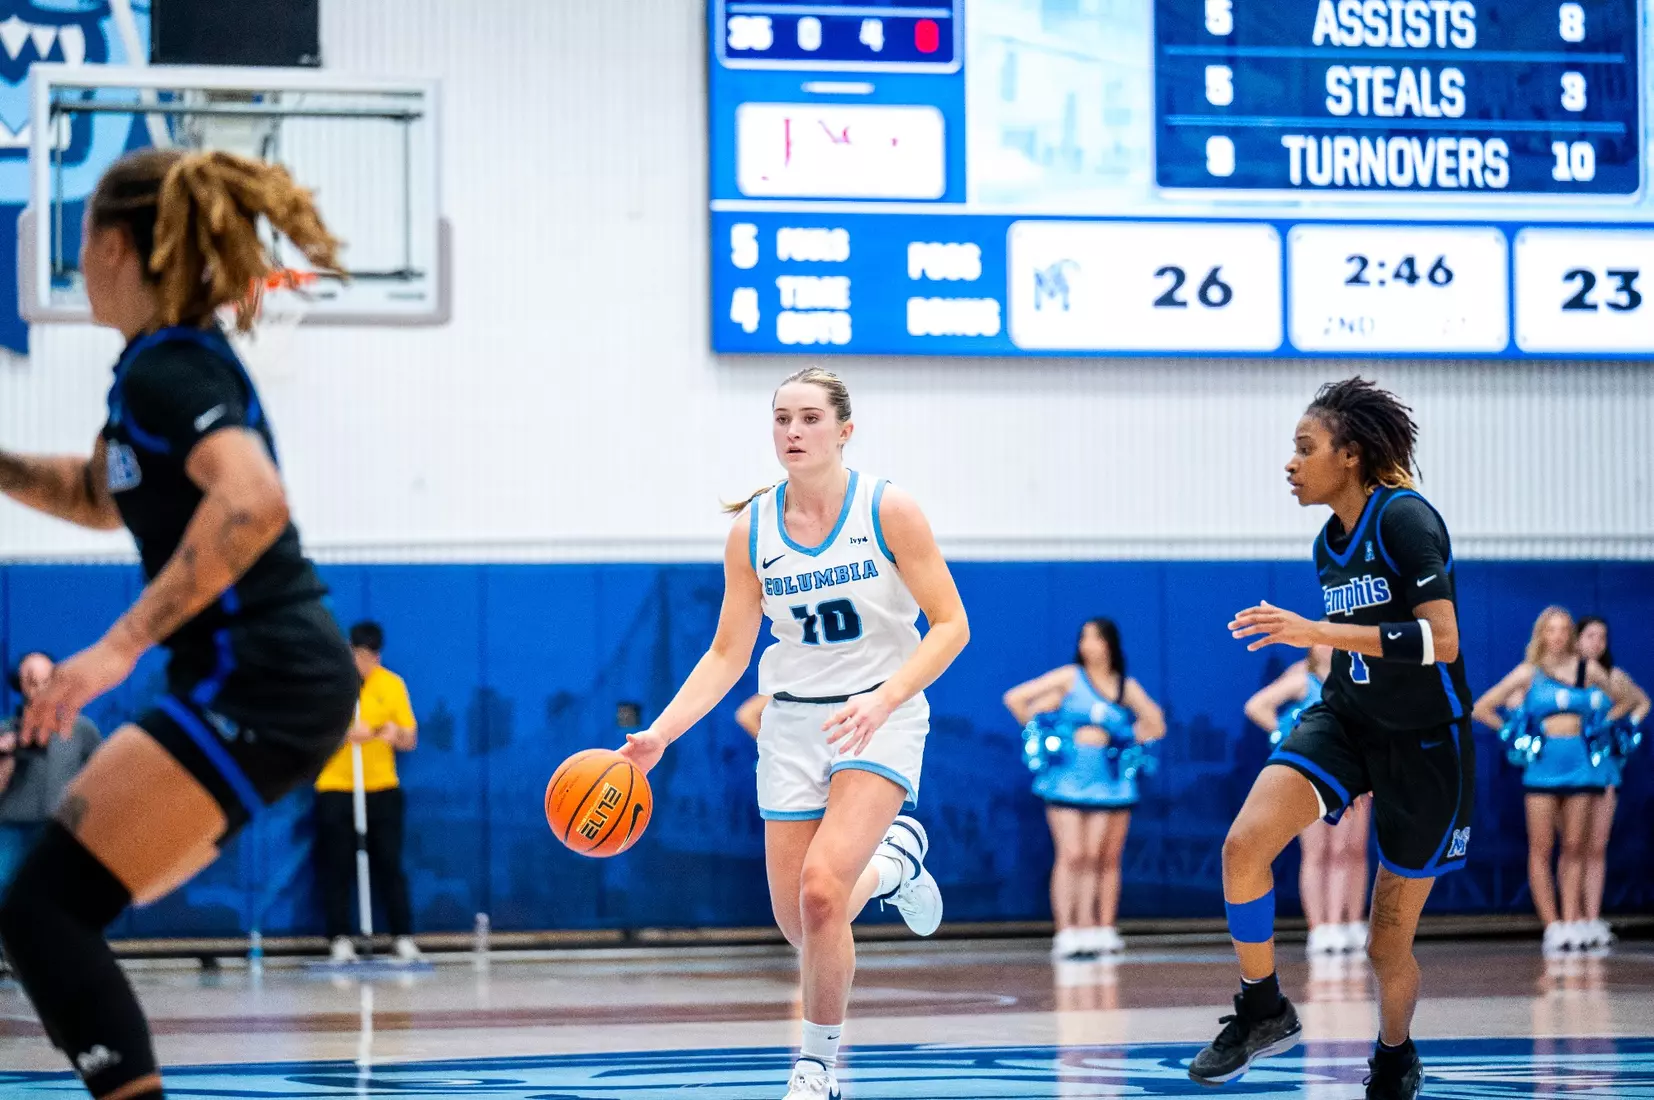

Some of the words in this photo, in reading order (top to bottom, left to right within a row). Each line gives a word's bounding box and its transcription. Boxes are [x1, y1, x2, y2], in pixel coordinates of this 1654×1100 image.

[1312, 0, 1476, 48] ASSISTS
[1559, 3, 1585, 42] 8
[1325, 66, 1465, 117] STEALS
[1281, 135, 1509, 188] TURNOVERS
[1552, 141, 1596, 182] 10
[1152, 264, 1233, 308] 26
[1344, 255, 1454, 287] 2:46
[1561, 268, 1643, 311] 23
[764, 559, 879, 596] COLUMBIA
[1322, 574, 1392, 616] emphis
[789, 597, 863, 645] 10
[579, 785, 623, 840] ELITE
